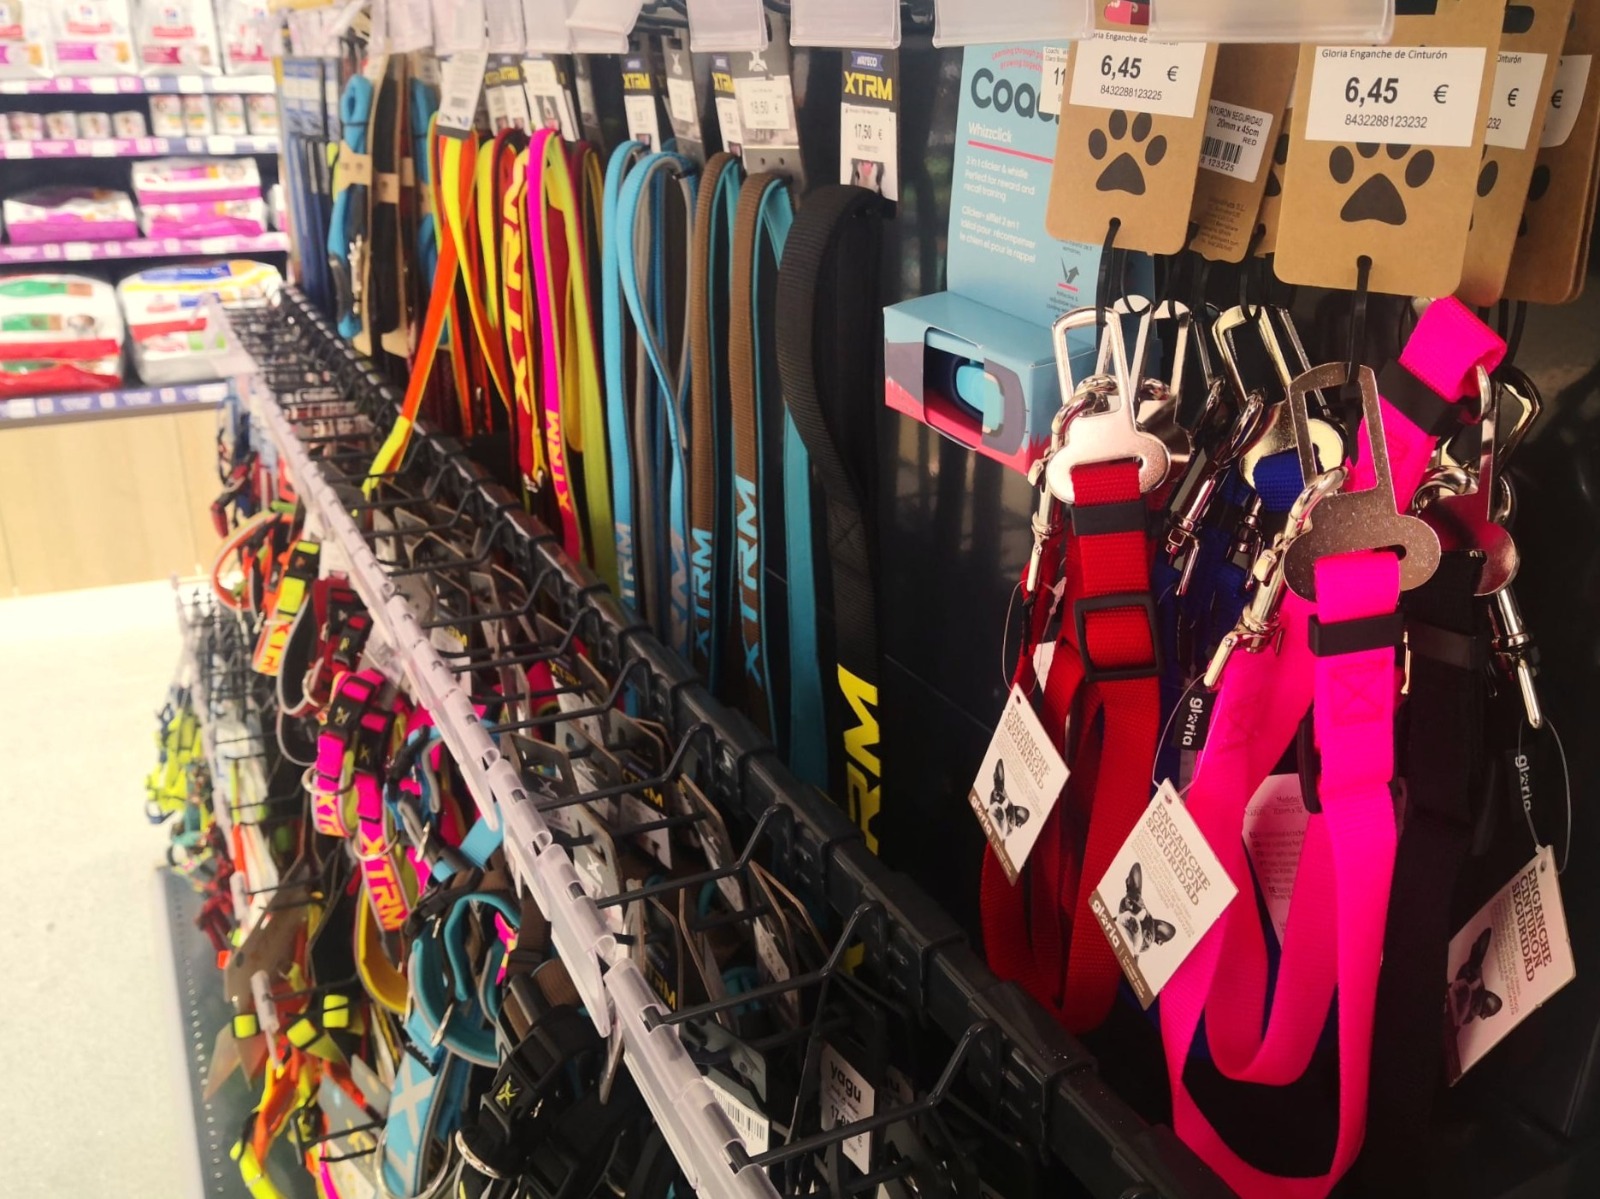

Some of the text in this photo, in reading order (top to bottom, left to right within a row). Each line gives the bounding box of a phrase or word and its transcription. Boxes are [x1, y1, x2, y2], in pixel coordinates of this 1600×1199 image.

[1106, 32, 1138, 42] Enganche
[1101, 54, 1179, 82] 6,45 €
[1321, 49, 1448, 60] Gloria Enganche de Cinturón
[843, 71, 893, 101] XTRM
[1100, 84, 1163, 101] 8432288123225
[1345, 76, 1450, 108] 6,45 €
[1507, 88, 1520, 107] €
[1551, 89, 1564, 109] €
[1216, 118, 1236, 131] 20mm
[1241, 124, 1260, 137] 45cm
[1344, 113, 1428, 129] 8432288123232
[1242, 136, 1257, 146] RED
[1208, 159, 1235, 172] 123225
[735, 474, 763, 689] XTRM
[1156, 801, 1211, 891] ENGANCHE
[1145, 816, 1199, 906] SEGURIDAD
[360, 831, 408, 931] XTRM
[1528, 866, 1553, 968] ENGANCHE
[1511, 881, 1535, 982] SEGURIDAD
[829, 1061, 862, 1104] yagu
